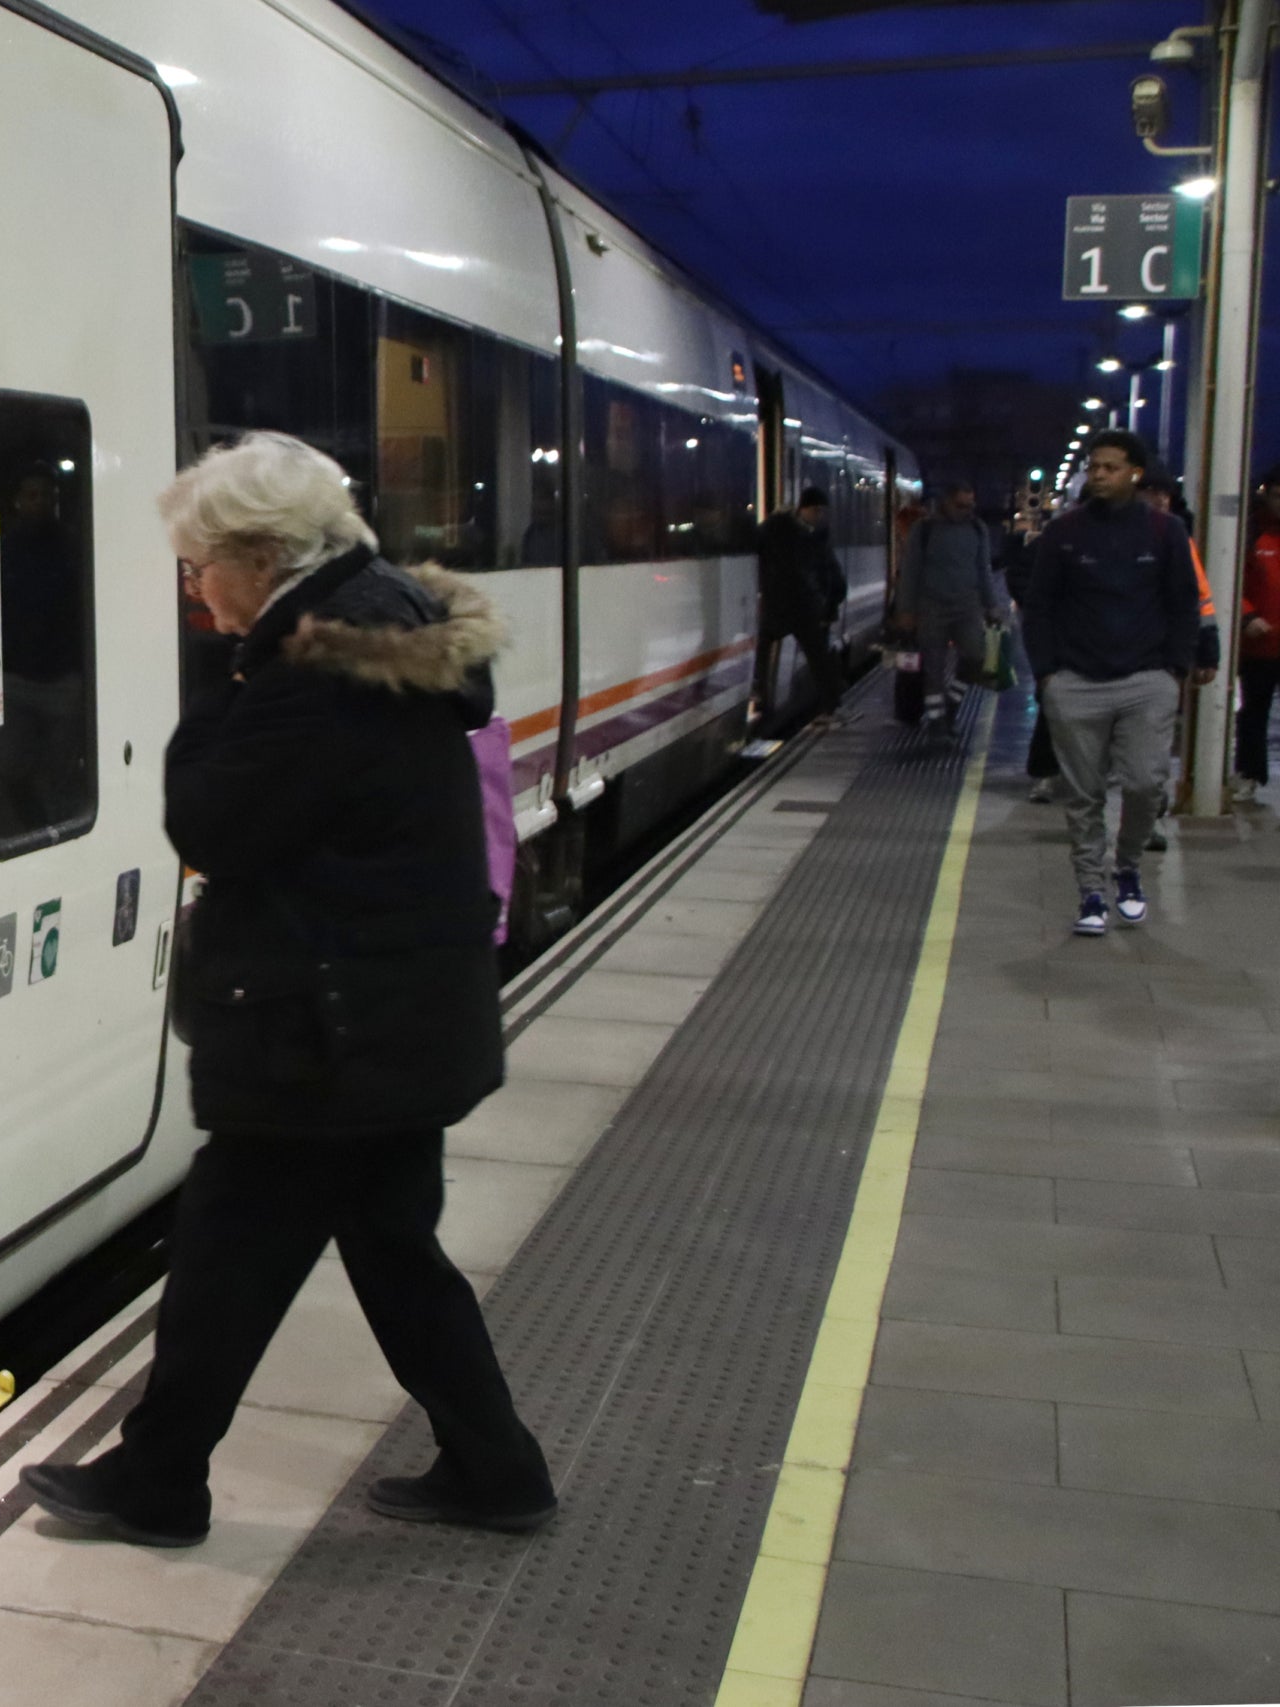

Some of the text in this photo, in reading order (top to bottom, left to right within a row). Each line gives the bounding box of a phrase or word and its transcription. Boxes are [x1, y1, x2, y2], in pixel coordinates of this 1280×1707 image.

[1139, 213, 1169, 222] Sector
[1080, 246, 1109, 294] 1
[1141, 245, 1169, 293] C
